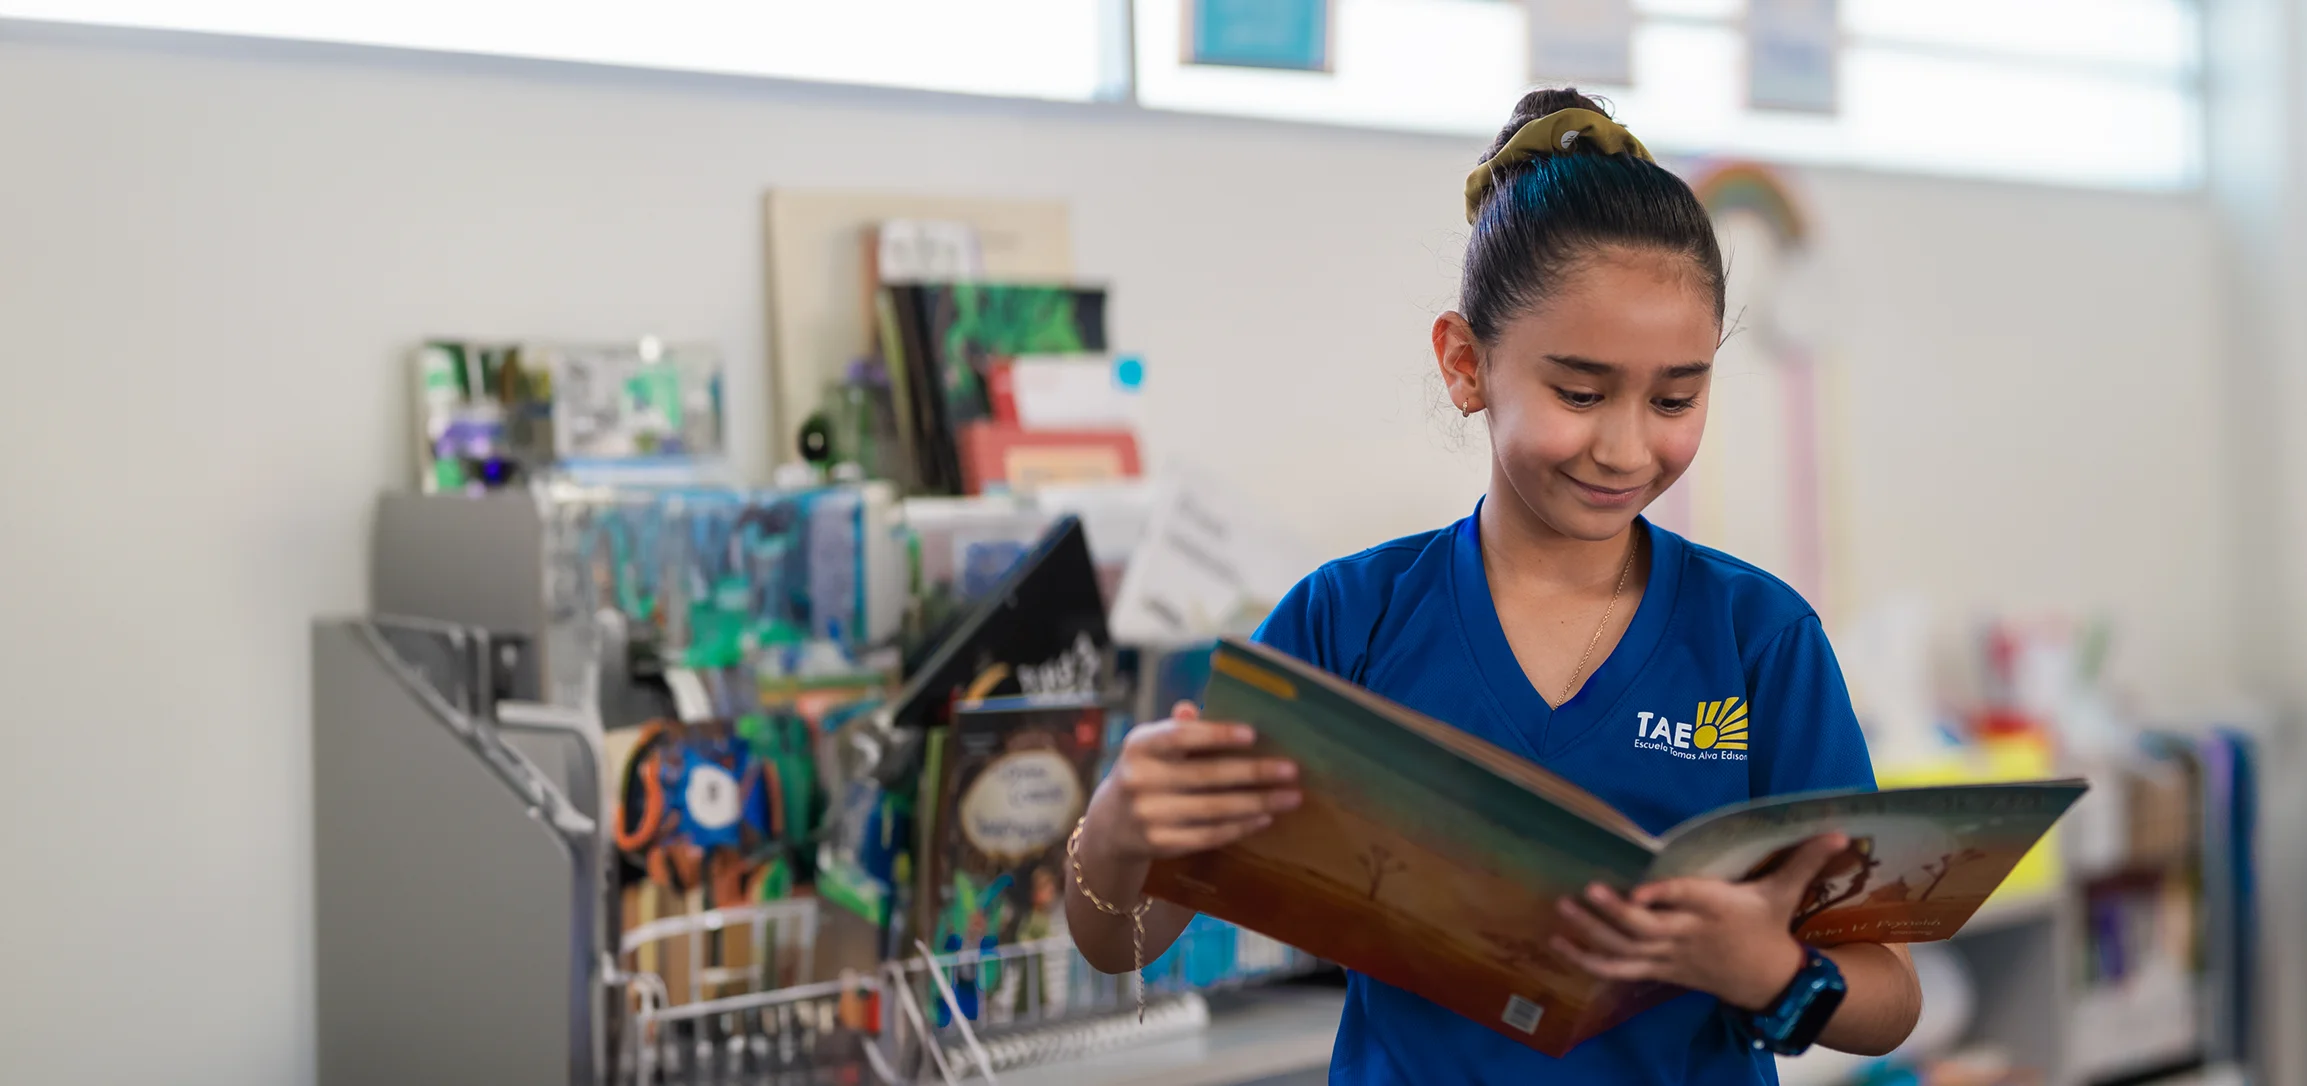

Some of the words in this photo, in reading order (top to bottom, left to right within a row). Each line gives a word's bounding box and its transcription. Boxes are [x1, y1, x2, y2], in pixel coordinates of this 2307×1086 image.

[1637, 711, 1692, 749] TAE
[1634, 738, 1668, 752] Escuela
[1669, 747, 1696, 760] Tomas
[1698, 751, 1718, 760] Alva
[1721, 750, 1748, 761] Edison
